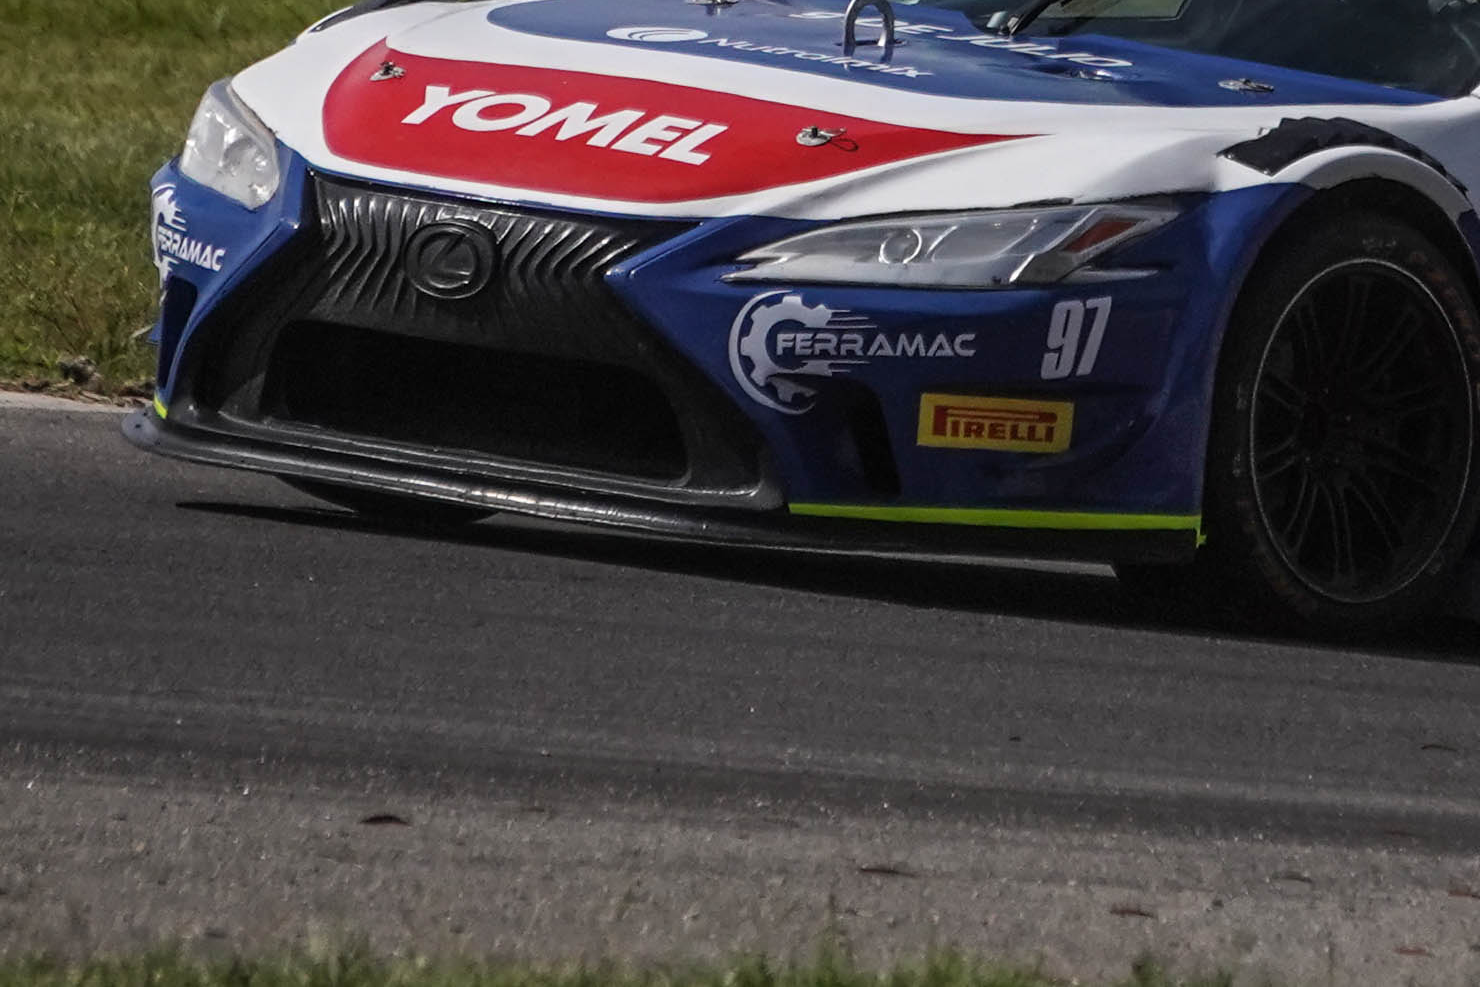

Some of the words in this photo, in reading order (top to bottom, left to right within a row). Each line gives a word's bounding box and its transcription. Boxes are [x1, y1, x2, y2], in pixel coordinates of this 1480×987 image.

[936, 34, 1133, 67] JULIO
[401, 85, 729, 165] YOMEL
[776, 332, 976, 358] FERRAMAC
[1040, 296, 1112, 380] 97
[932, 405, 1058, 444] PIRELLI
